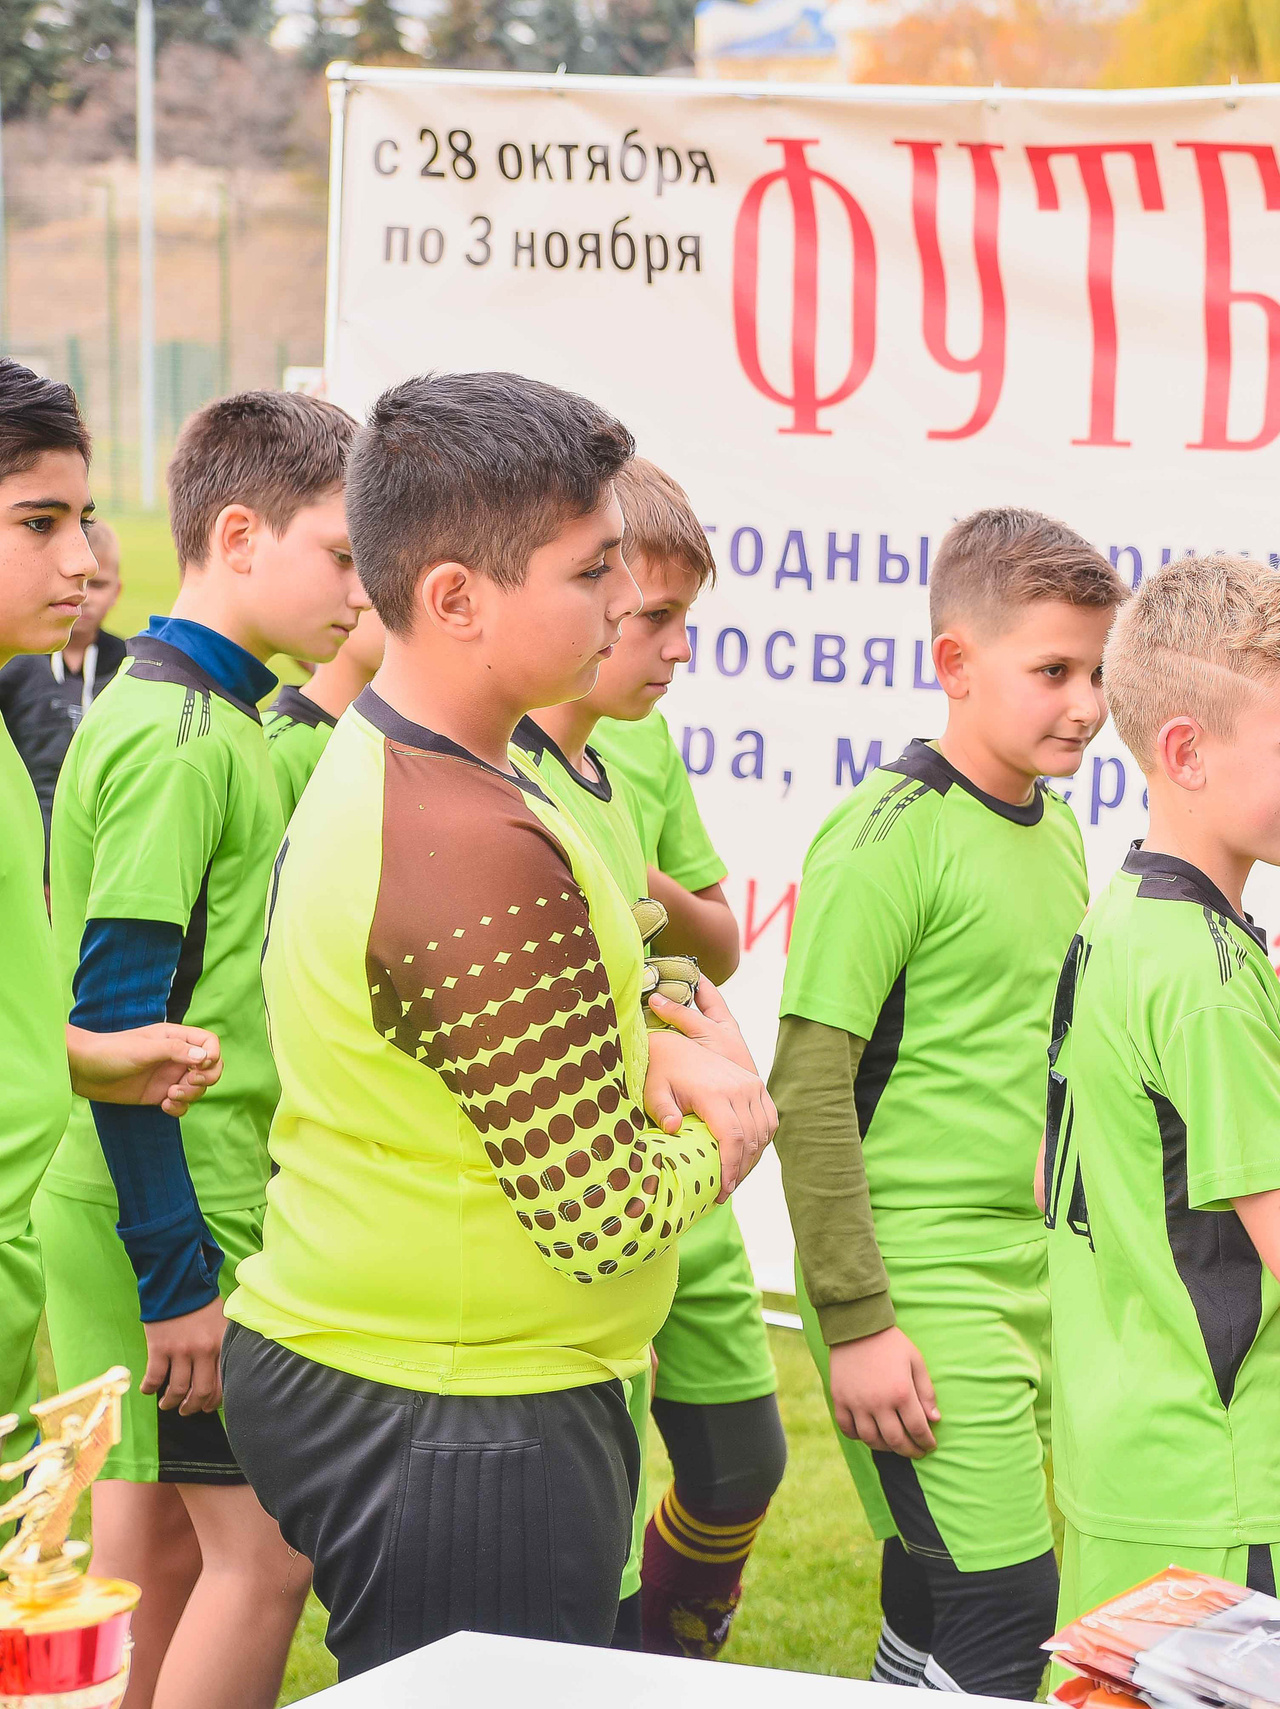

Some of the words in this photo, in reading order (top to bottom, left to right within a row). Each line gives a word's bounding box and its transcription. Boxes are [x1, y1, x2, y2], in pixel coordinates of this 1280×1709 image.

[373, 139, 400, 176] с
[419, 126, 477, 181] 28
[498, 128, 718, 196] октября
[383, 224, 445, 266] по
[464, 214, 492, 268] 3
[513, 215, 702, 285] ноября
[701, 524, 930, 593] одны
